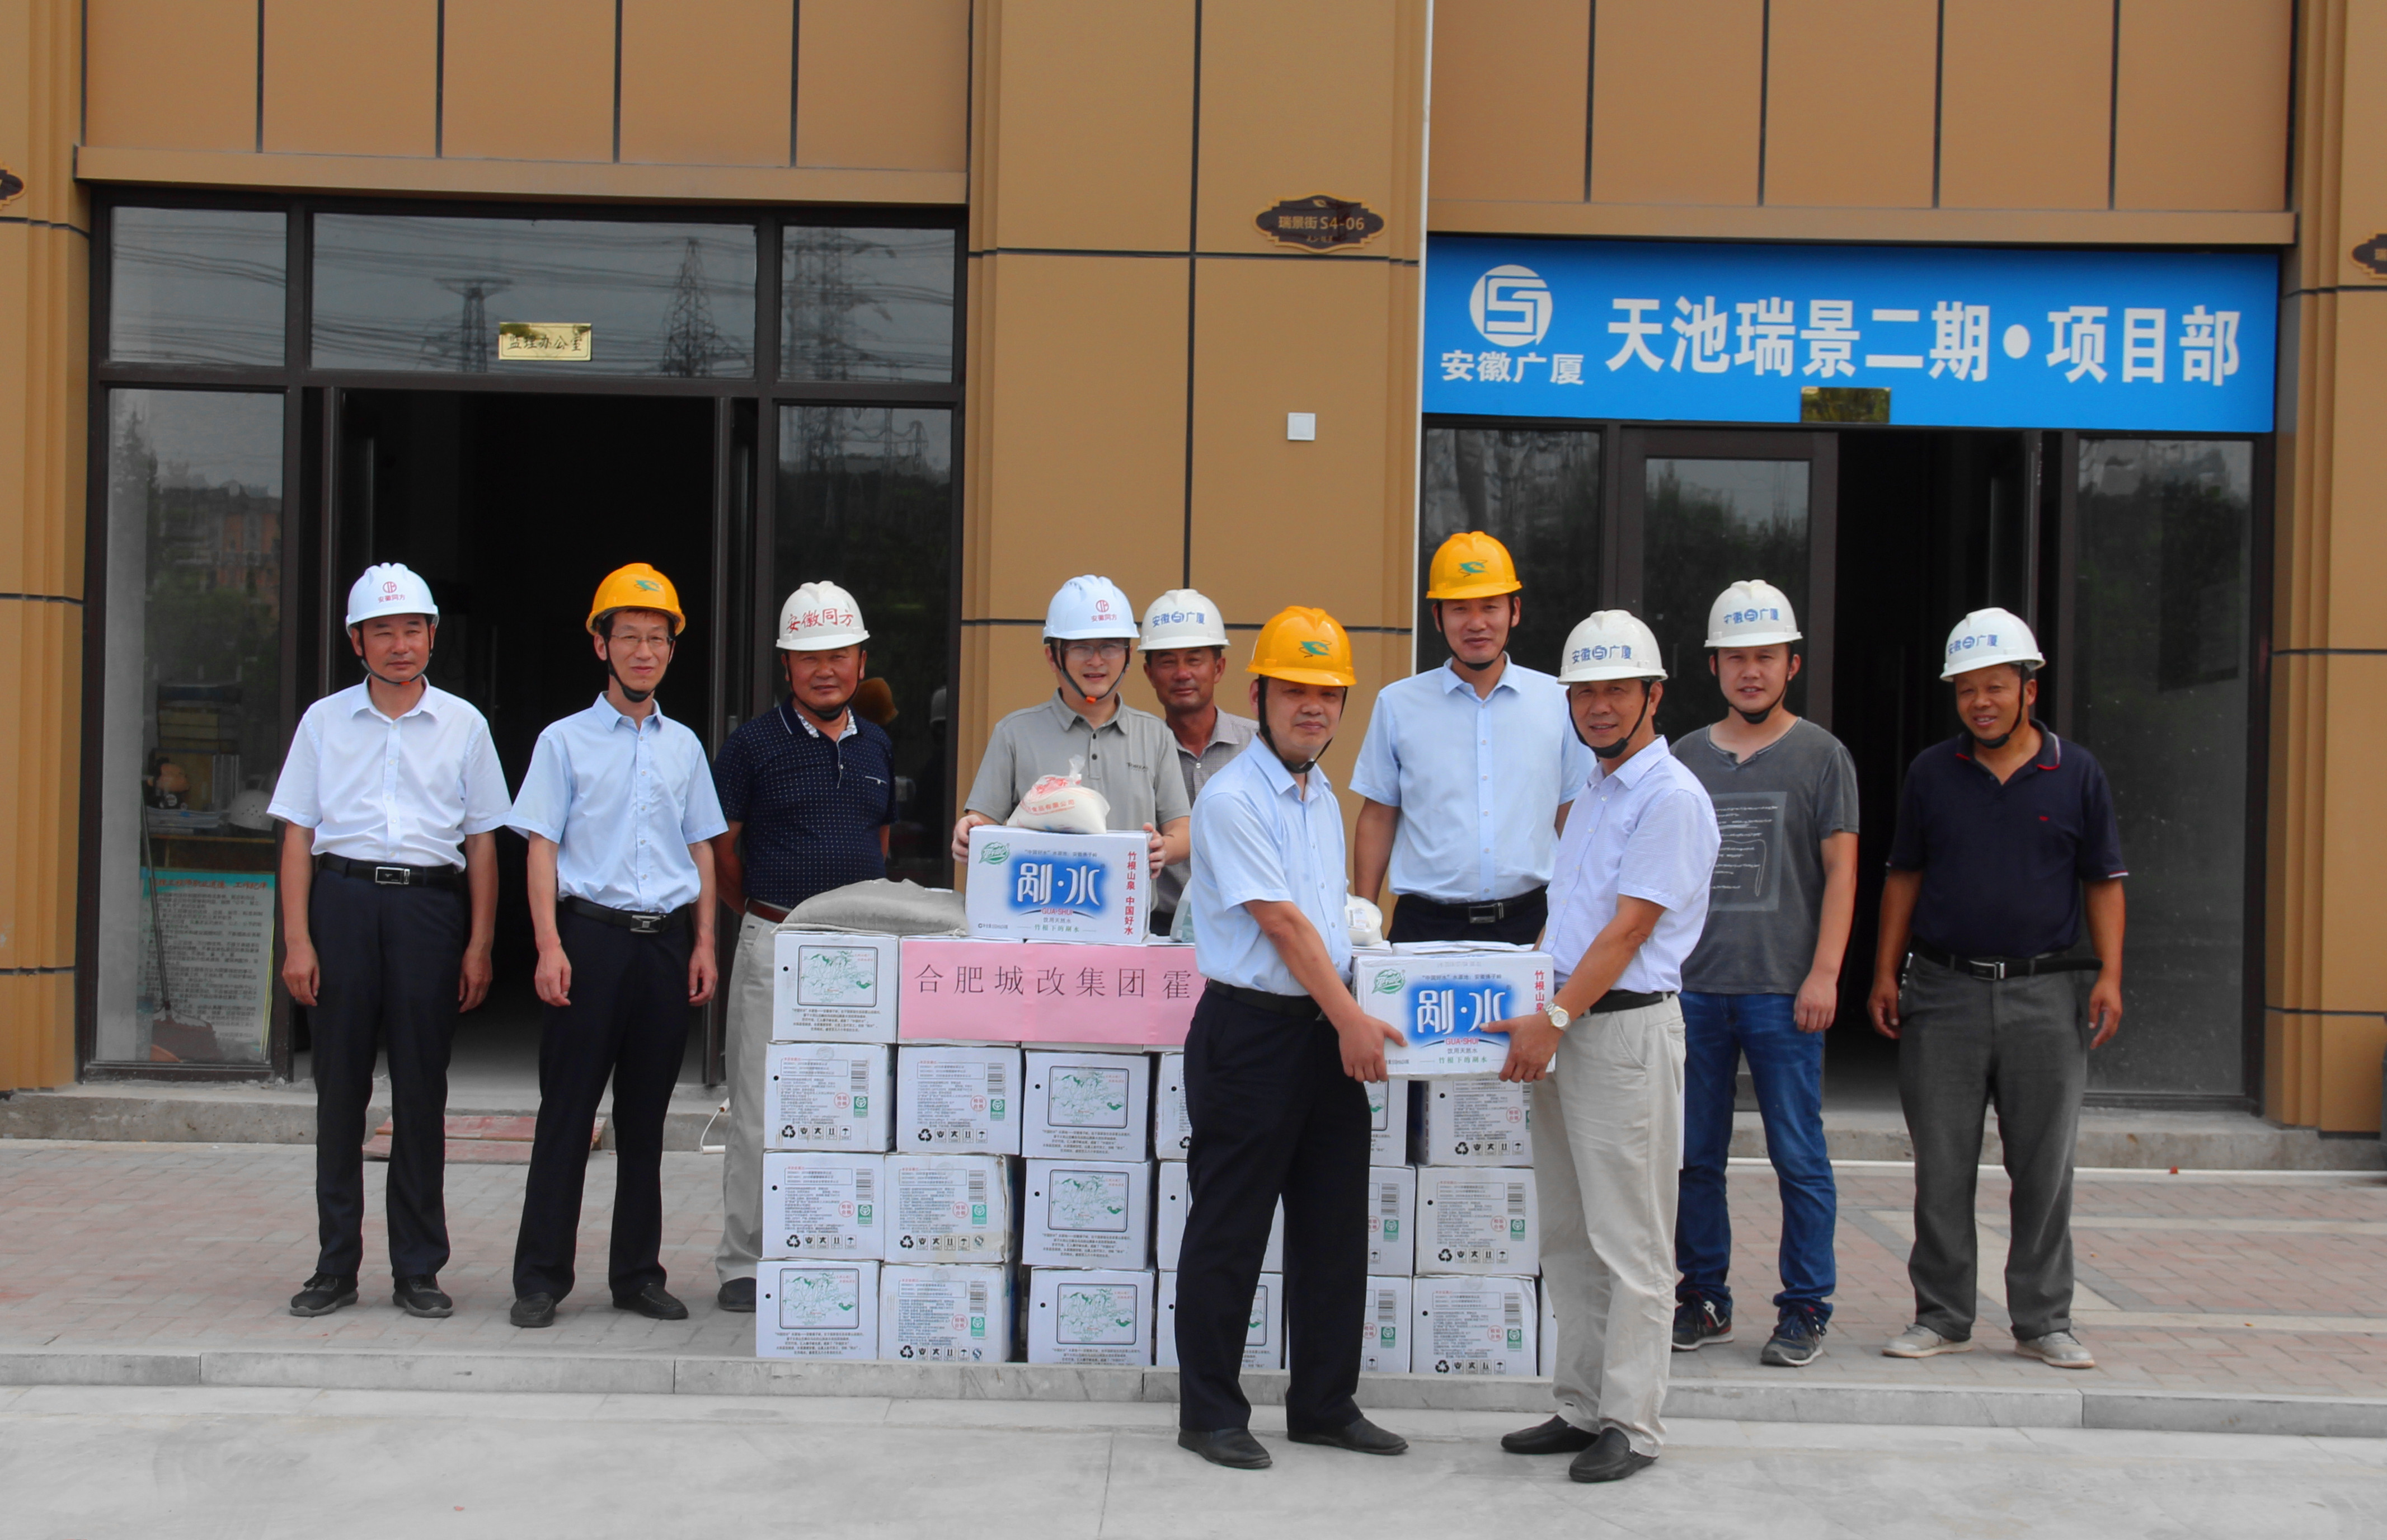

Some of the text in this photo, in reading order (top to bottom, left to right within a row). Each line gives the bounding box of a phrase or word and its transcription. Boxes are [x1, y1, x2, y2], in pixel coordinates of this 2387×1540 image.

[1319, 217, 1365, 231] S4-06
[507, 335, 583, 351] 监理办公室
[1440, 349, 1585, 386] 安徽广厦
[378, 594, 406, 603] 安徽同方
[787, 608, 854, 633] 安徽同方
[1091, 614, 1117, 622] 安徽同方
[1152, 611, 1205, 628] 安徽 广厦
[1759, 608, 1779, 621] 广厦
[1572, 645, 1632, 665] 安徽 广厦
[1124, 851, 1136, 936] 竹根山泉 中国好水
[915, 964, 1192, 999] 合肥城改集团霍
[1534, 970, 1545, 1012] 竹根山泉
